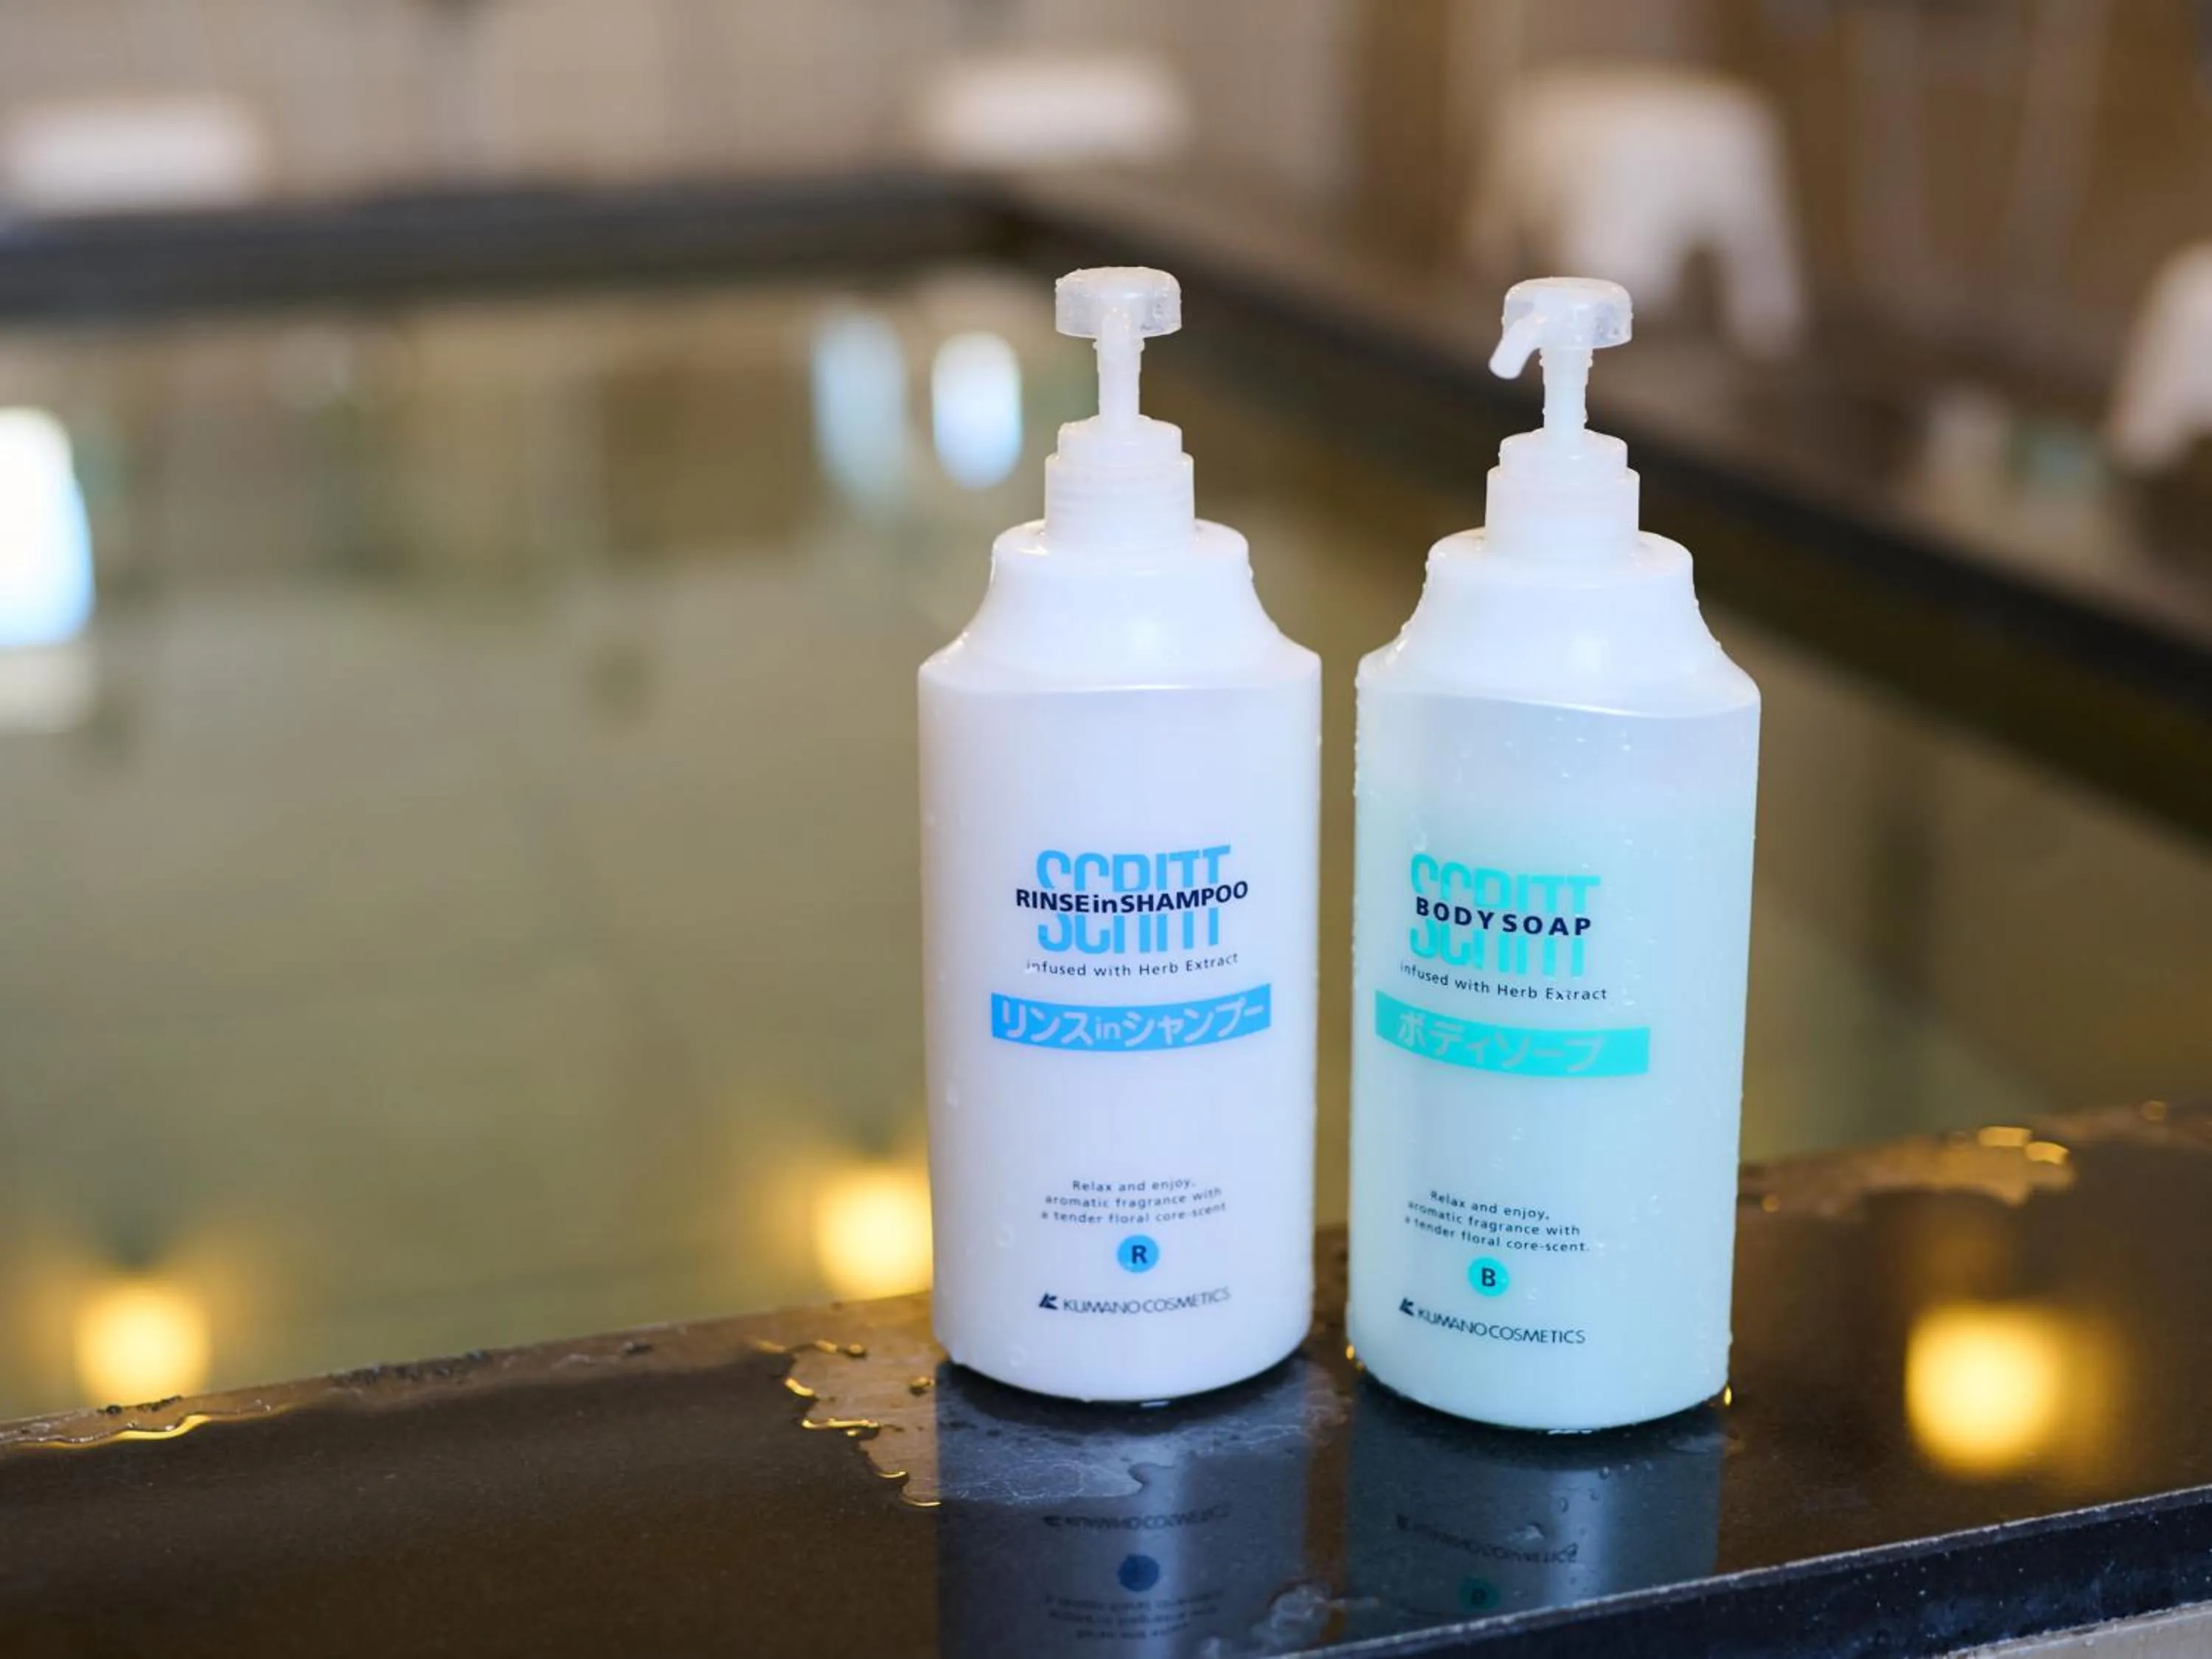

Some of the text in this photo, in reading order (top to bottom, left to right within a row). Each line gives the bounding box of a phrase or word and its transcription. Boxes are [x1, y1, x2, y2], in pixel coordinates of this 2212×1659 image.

[1026, 952, 1239, 977] infused with Herb Extract
[1399, 962, 1607, 1001] infused with Herb Extract
[1045, 1186, 1222, 1210] aromatic fragrance with
[1072, 1180, 1112, 1192] Relax
[1118, 1180, 1146, 1192] and
[1430, 1189, 1466, 1209] Relax
[1471, 1203, 1498, 1214] and
[1041, 1211, 1048, 1220] a
[1053, 1210, 1104, 1223] tender
[1109, 1212, 1150, 1224] floral
[1407, 1200, 1581, 1236] aromatic fragrance with
[1404, 1215, 1411, 1225] a
[1414, 1217, 1455, 1238] tender
[1461, 1229, 1501, 1248] floral
[1130, 1244, 1148, 1264] R
[1481, 1267, 1497, 1287] B
